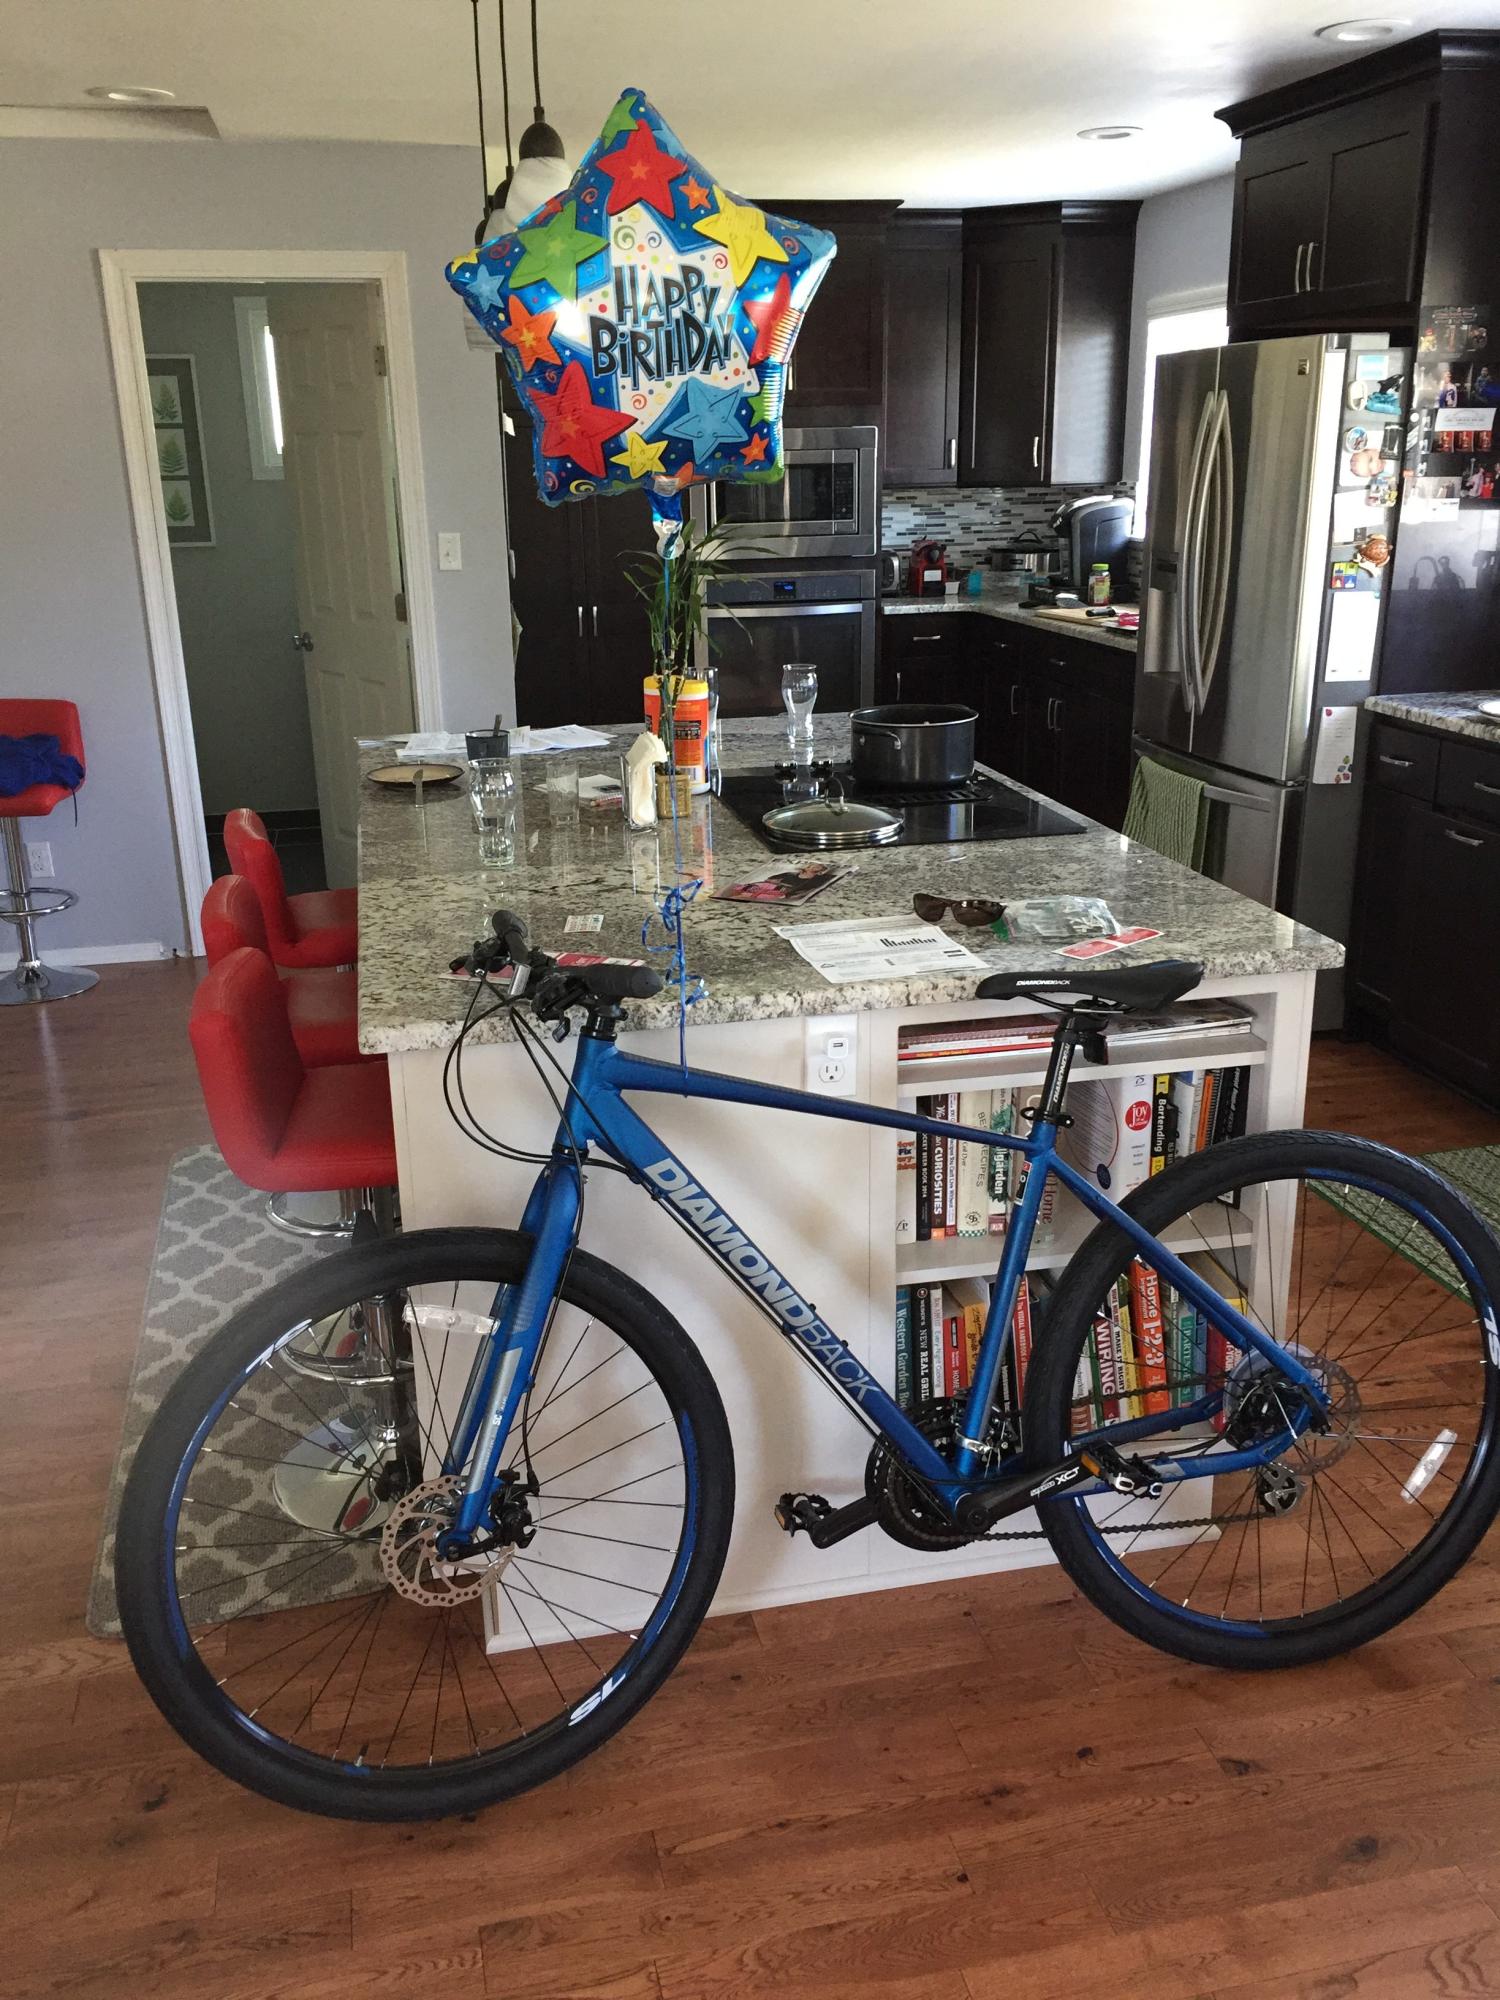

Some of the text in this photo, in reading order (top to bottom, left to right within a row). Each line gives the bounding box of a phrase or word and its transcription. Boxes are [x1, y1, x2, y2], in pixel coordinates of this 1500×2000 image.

[614, 264, 721, 327] HAPPY
[1154, 1098, 1168, 1153] Bartending
[933, 1147, 944, 1216] CURIOSITIES
[643, 1157, 883, 1402] DIAMONDBACK
[1145, 1274, 1158, 1318] Home
[896, 1307, 907, 1351] Western
[919, 1328, 928, 1350] NEW
[898, 1352, 910, 1387] Garden
[920, 1350, 929, 1376] REAL
[1096, 1321, 1117, 1397] WIRING
[1117, 1365, 1125, 1393] RIGHT
[1056, 1466, 1080, 1485] XCT
